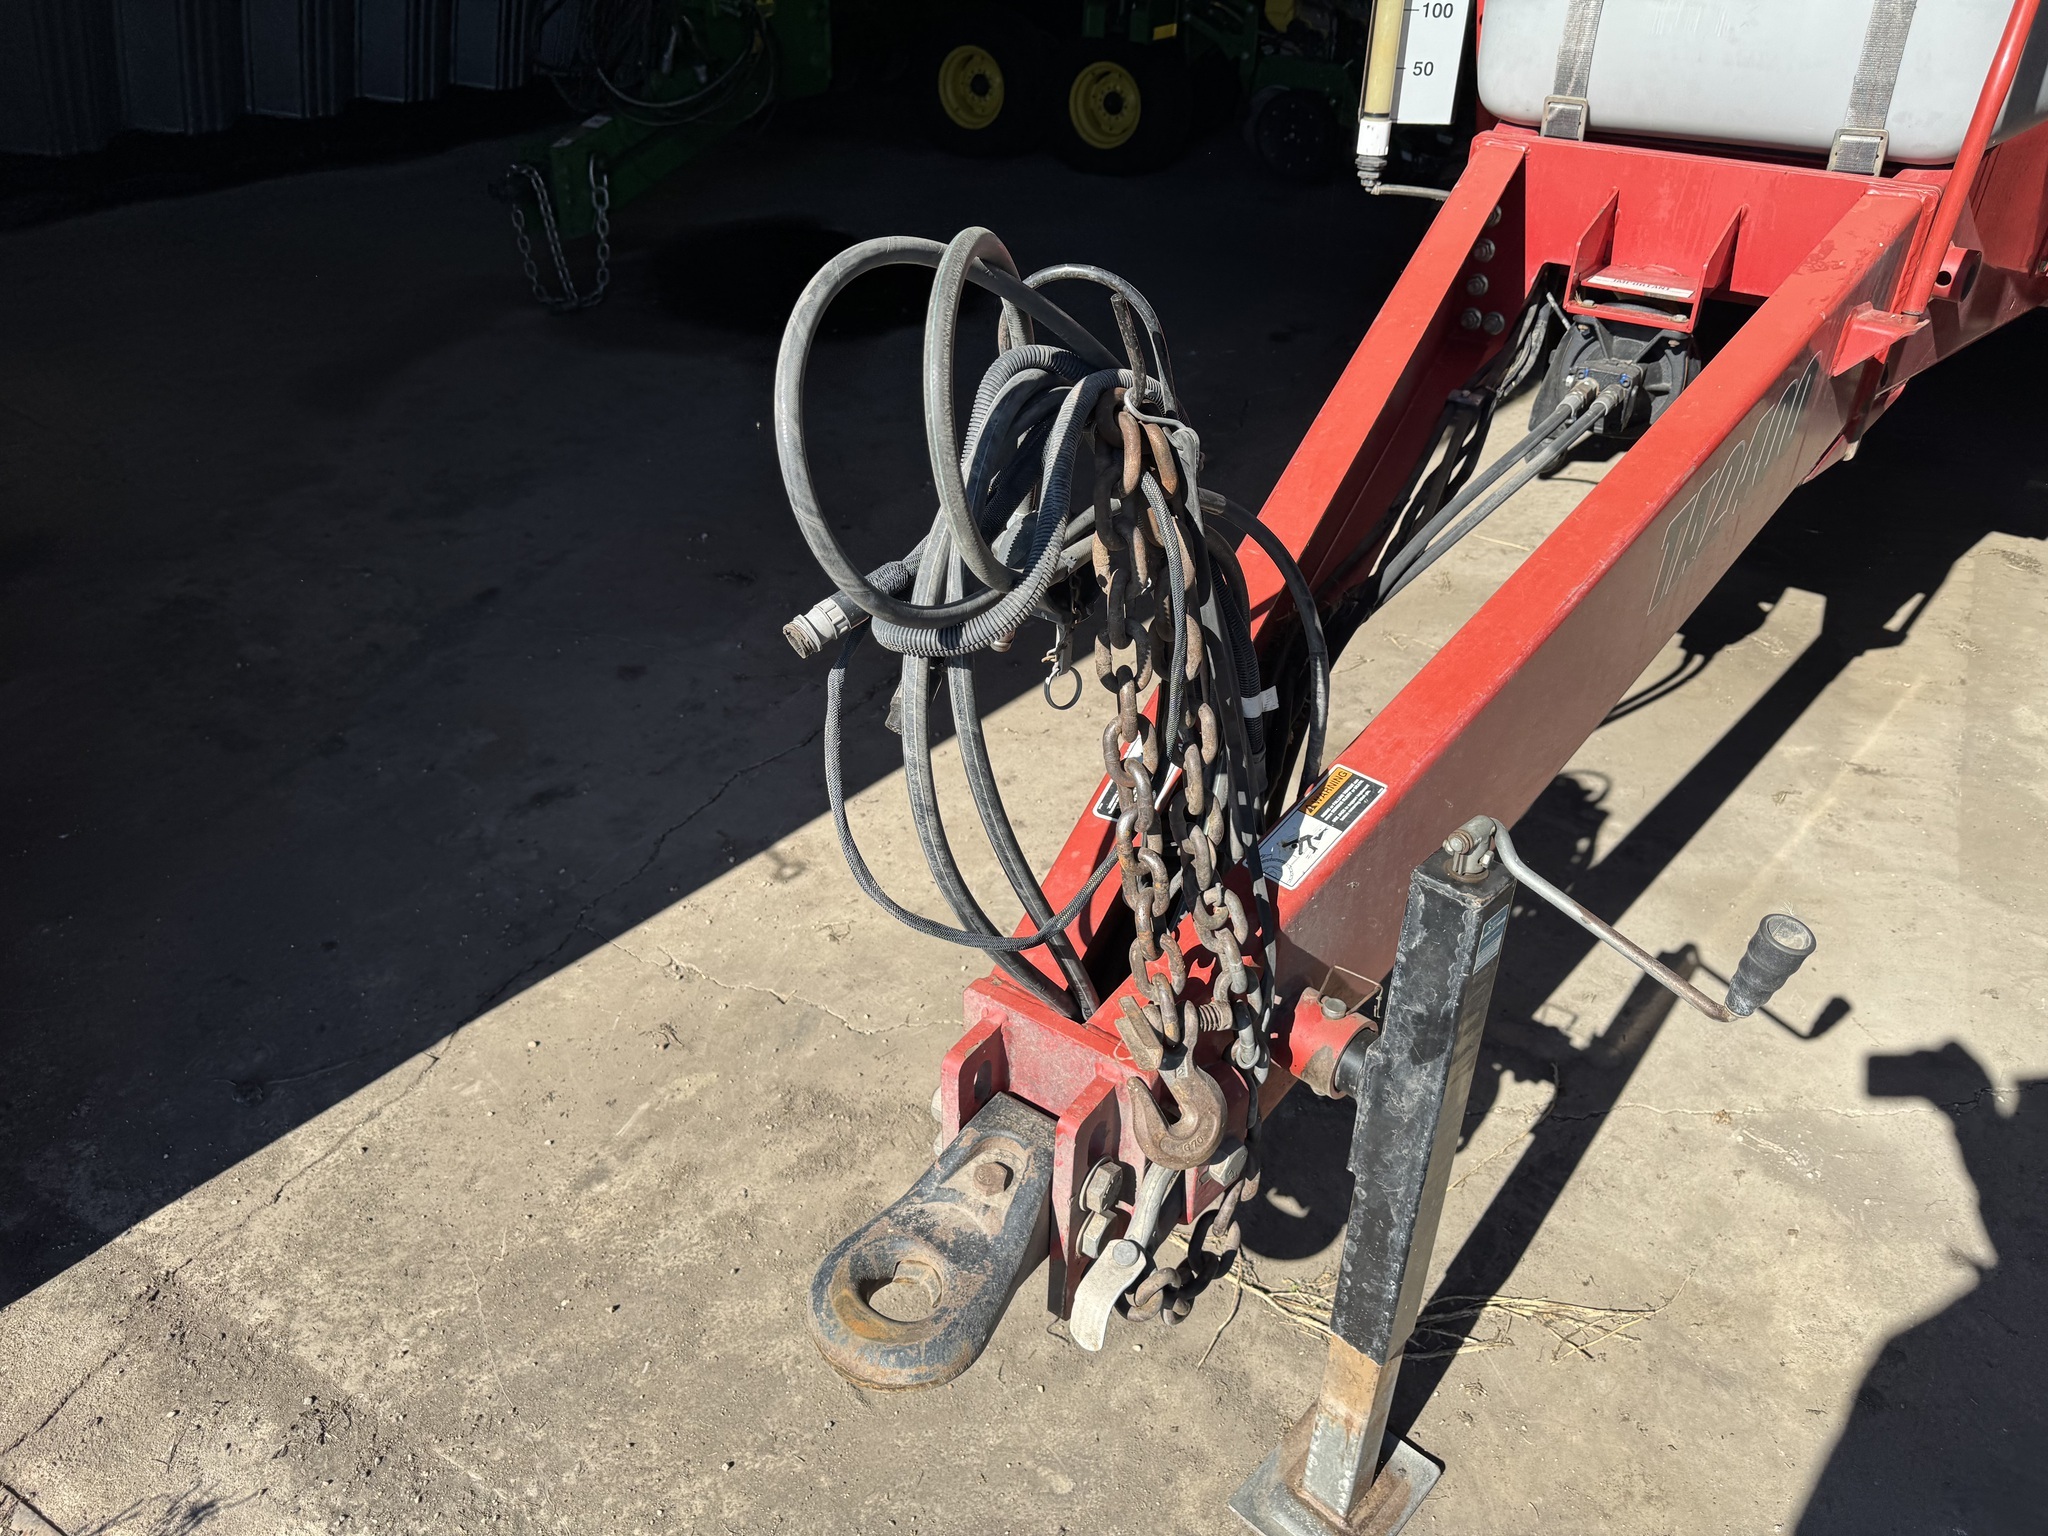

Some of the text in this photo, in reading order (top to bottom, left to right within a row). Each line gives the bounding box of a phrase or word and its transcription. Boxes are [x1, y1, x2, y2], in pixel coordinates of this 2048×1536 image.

[1422, 2, 1454, 18] 100
[1412, 61, 1434, 76] 50
[1313, 770, 1348, 807] WARNING
[1183, 1136, 1204, 1152] G70
